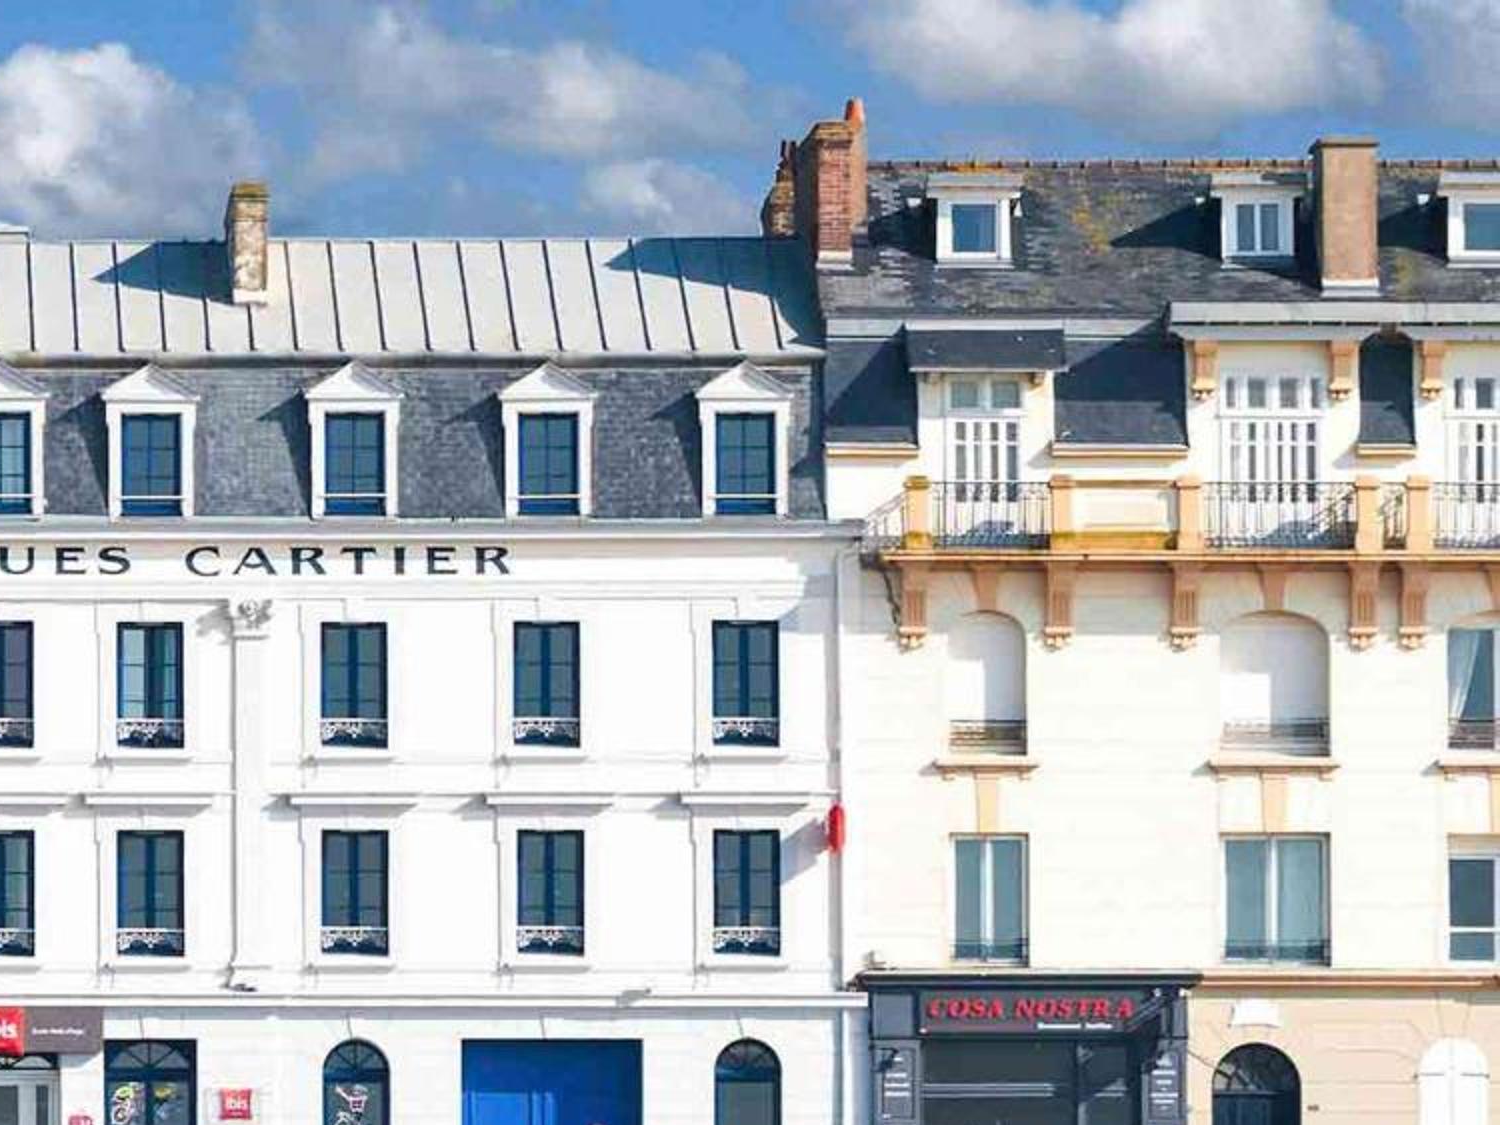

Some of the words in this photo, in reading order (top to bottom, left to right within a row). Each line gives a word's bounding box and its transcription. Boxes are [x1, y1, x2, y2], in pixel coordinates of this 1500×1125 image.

[185, 545, 509, 575] CARTIER
[926, 997, 1004, 1018] COSA
[1013, 996, 1135, 1018] NOSTRA
